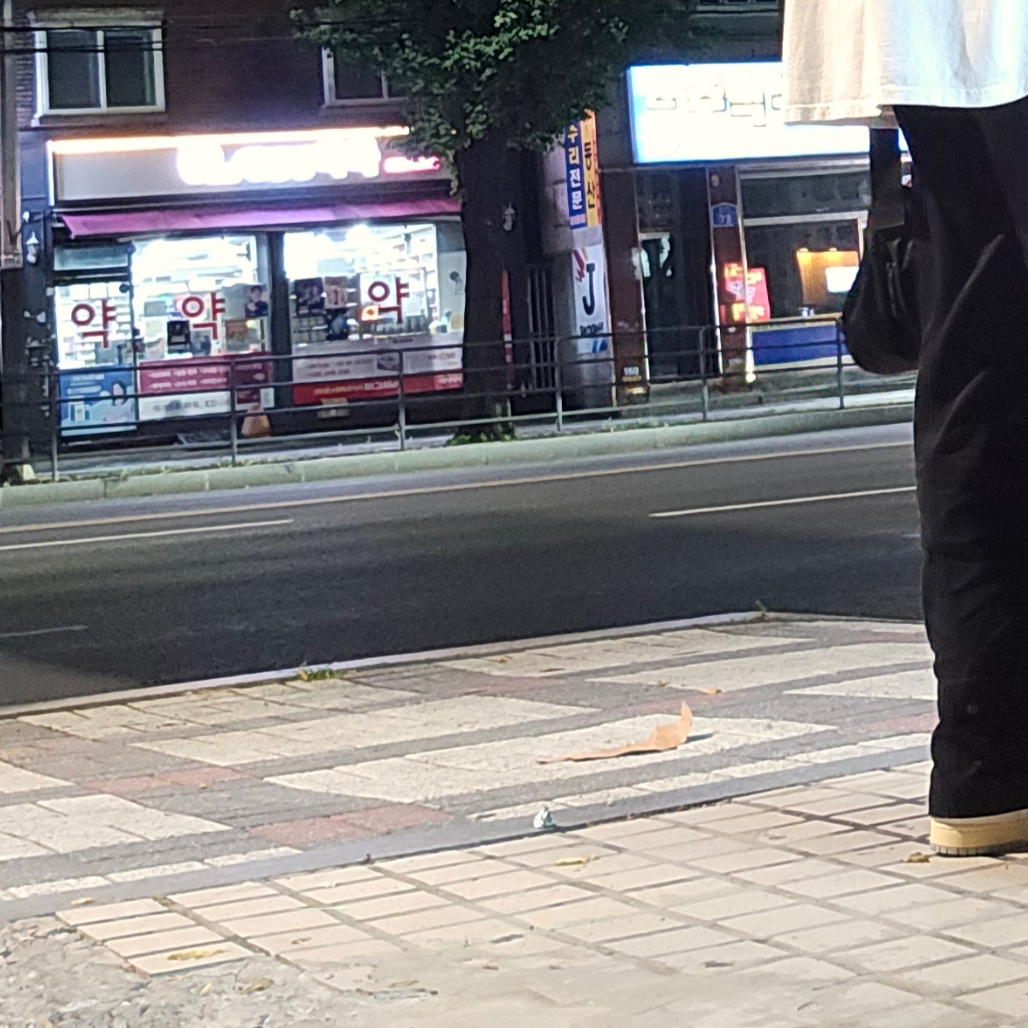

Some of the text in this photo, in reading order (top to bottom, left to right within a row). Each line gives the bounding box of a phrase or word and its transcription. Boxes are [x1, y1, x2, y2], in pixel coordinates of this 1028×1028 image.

[70, 299, 116, 349] 약
[181, 291, 226, 341] 약
[367, 276, 410, 324] 약
